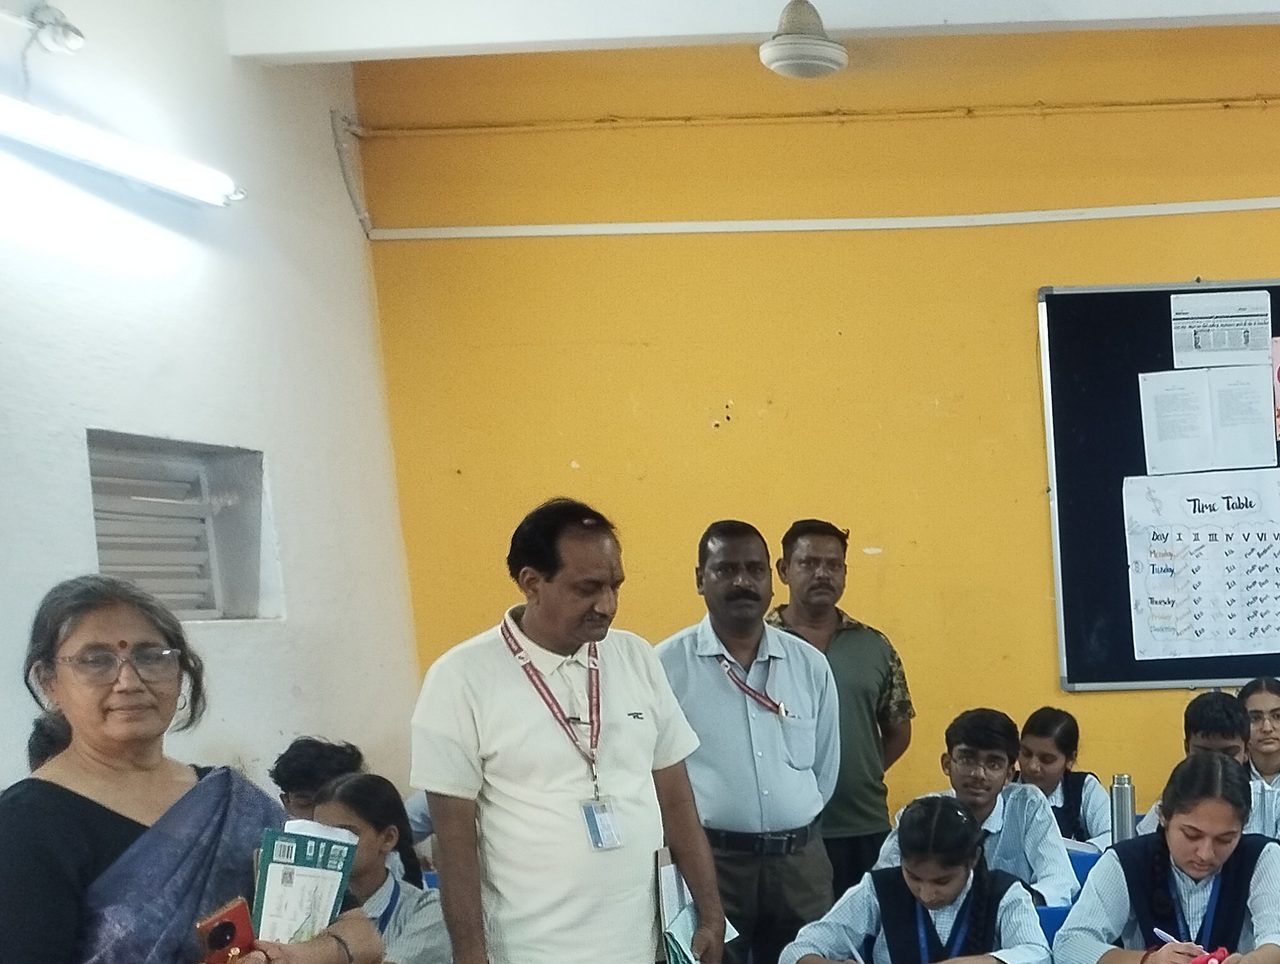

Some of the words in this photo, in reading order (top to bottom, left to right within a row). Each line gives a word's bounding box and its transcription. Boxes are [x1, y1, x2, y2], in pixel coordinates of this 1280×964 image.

[1221, 495, 1257, 511] Table
[1151, 530, 1169, 543] Day
[1242, 532, 1251, 542] V
[1256, 532, 1267, 542] VI
